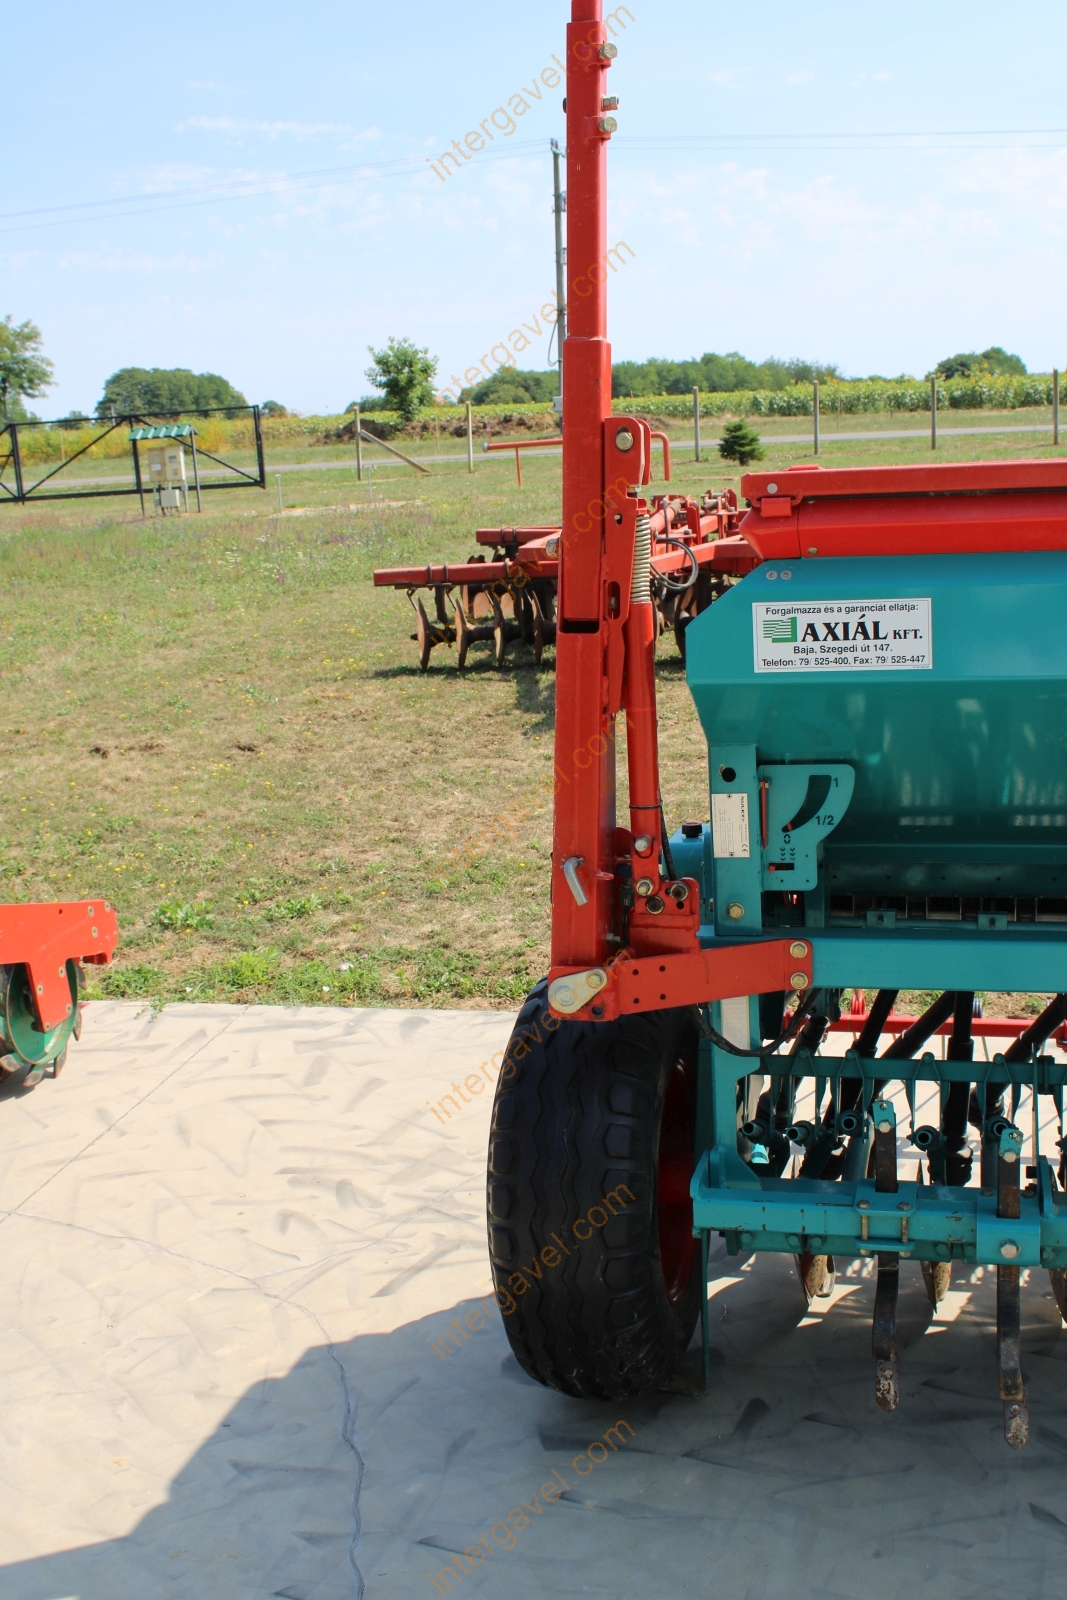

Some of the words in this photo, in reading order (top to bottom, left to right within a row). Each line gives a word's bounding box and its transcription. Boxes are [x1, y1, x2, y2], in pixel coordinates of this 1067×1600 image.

[766, 605, 822, 616] Forgalmazza
[824, 605, 835, 613] és
[844, 603, 887, 614] garanciát
[888, 603, 918, 612] ellátja:
[800, 614, 888, 642] AXIÁL
[892, 629, 922, 640] KFT.
[794, 646, 817, 654] Baja,
[819, 644, 858, 655] Szegedi
[860, 644, 870, 652] út
[874, 644, 892, 652] 147.
[762, 658, 796, 667] Telefon:
[798, 658, 812, 666] 79/
[854, 656, 872, 665] Fax:
[875, 656, 889, 664] 79/
[890, 655, 926, 664] 525-447
[834, 778, 839, 787] 1
[816, 815, 834, 826] 1/2
